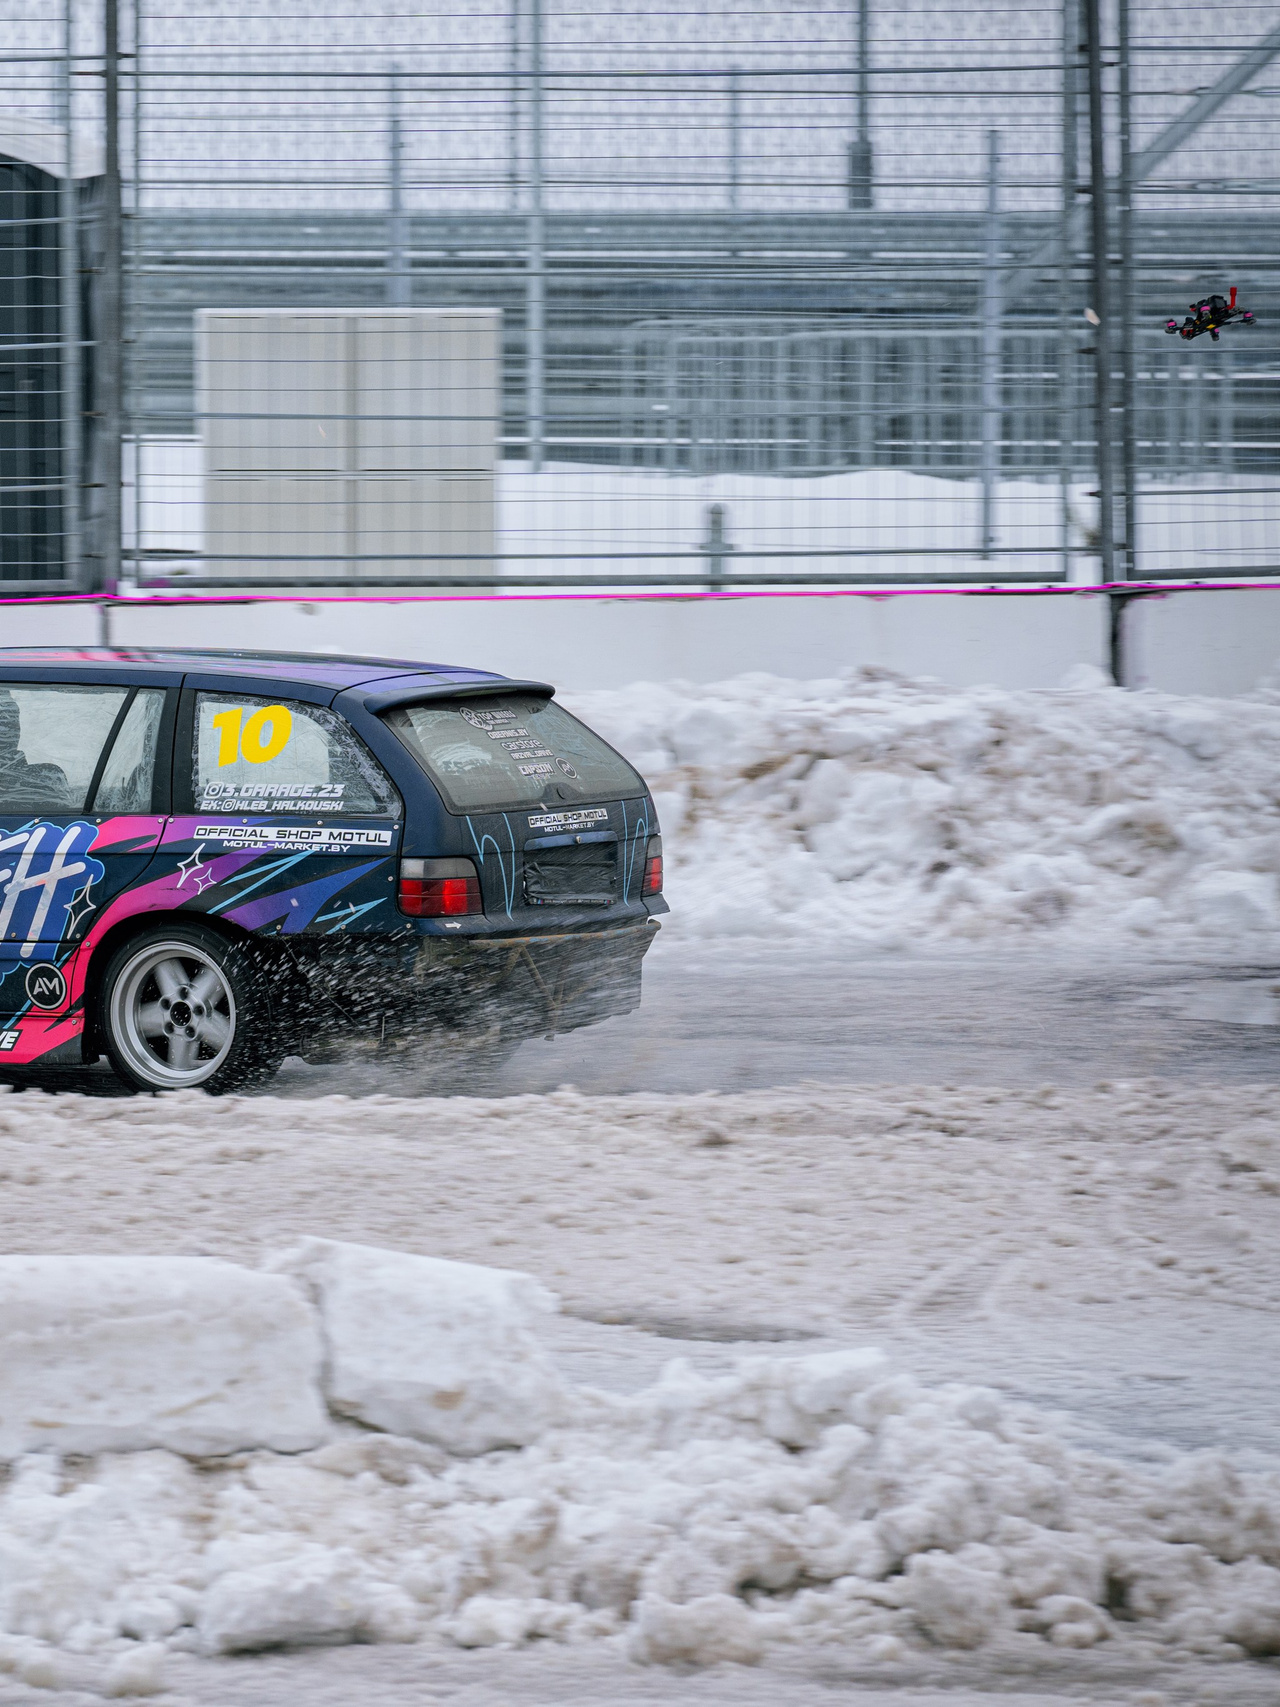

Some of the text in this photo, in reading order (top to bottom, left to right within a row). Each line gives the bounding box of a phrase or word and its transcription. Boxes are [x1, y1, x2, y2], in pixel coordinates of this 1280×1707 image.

[212, 704, 293, 768] 10
[221, 783, 346, 798] 3.GARAGE.23
[529, 809, 607, 826] OFFICIAL SHOP MOTUL
[195, 827, 389, 844] OFFICIAL SHOP MOTUL
[544, 821, 596, 833] MOTUL-MARKET.BY
[222, 840, 351, 853] MOTUL-MARKET.BY
[32, 977, 60, 995] AM
